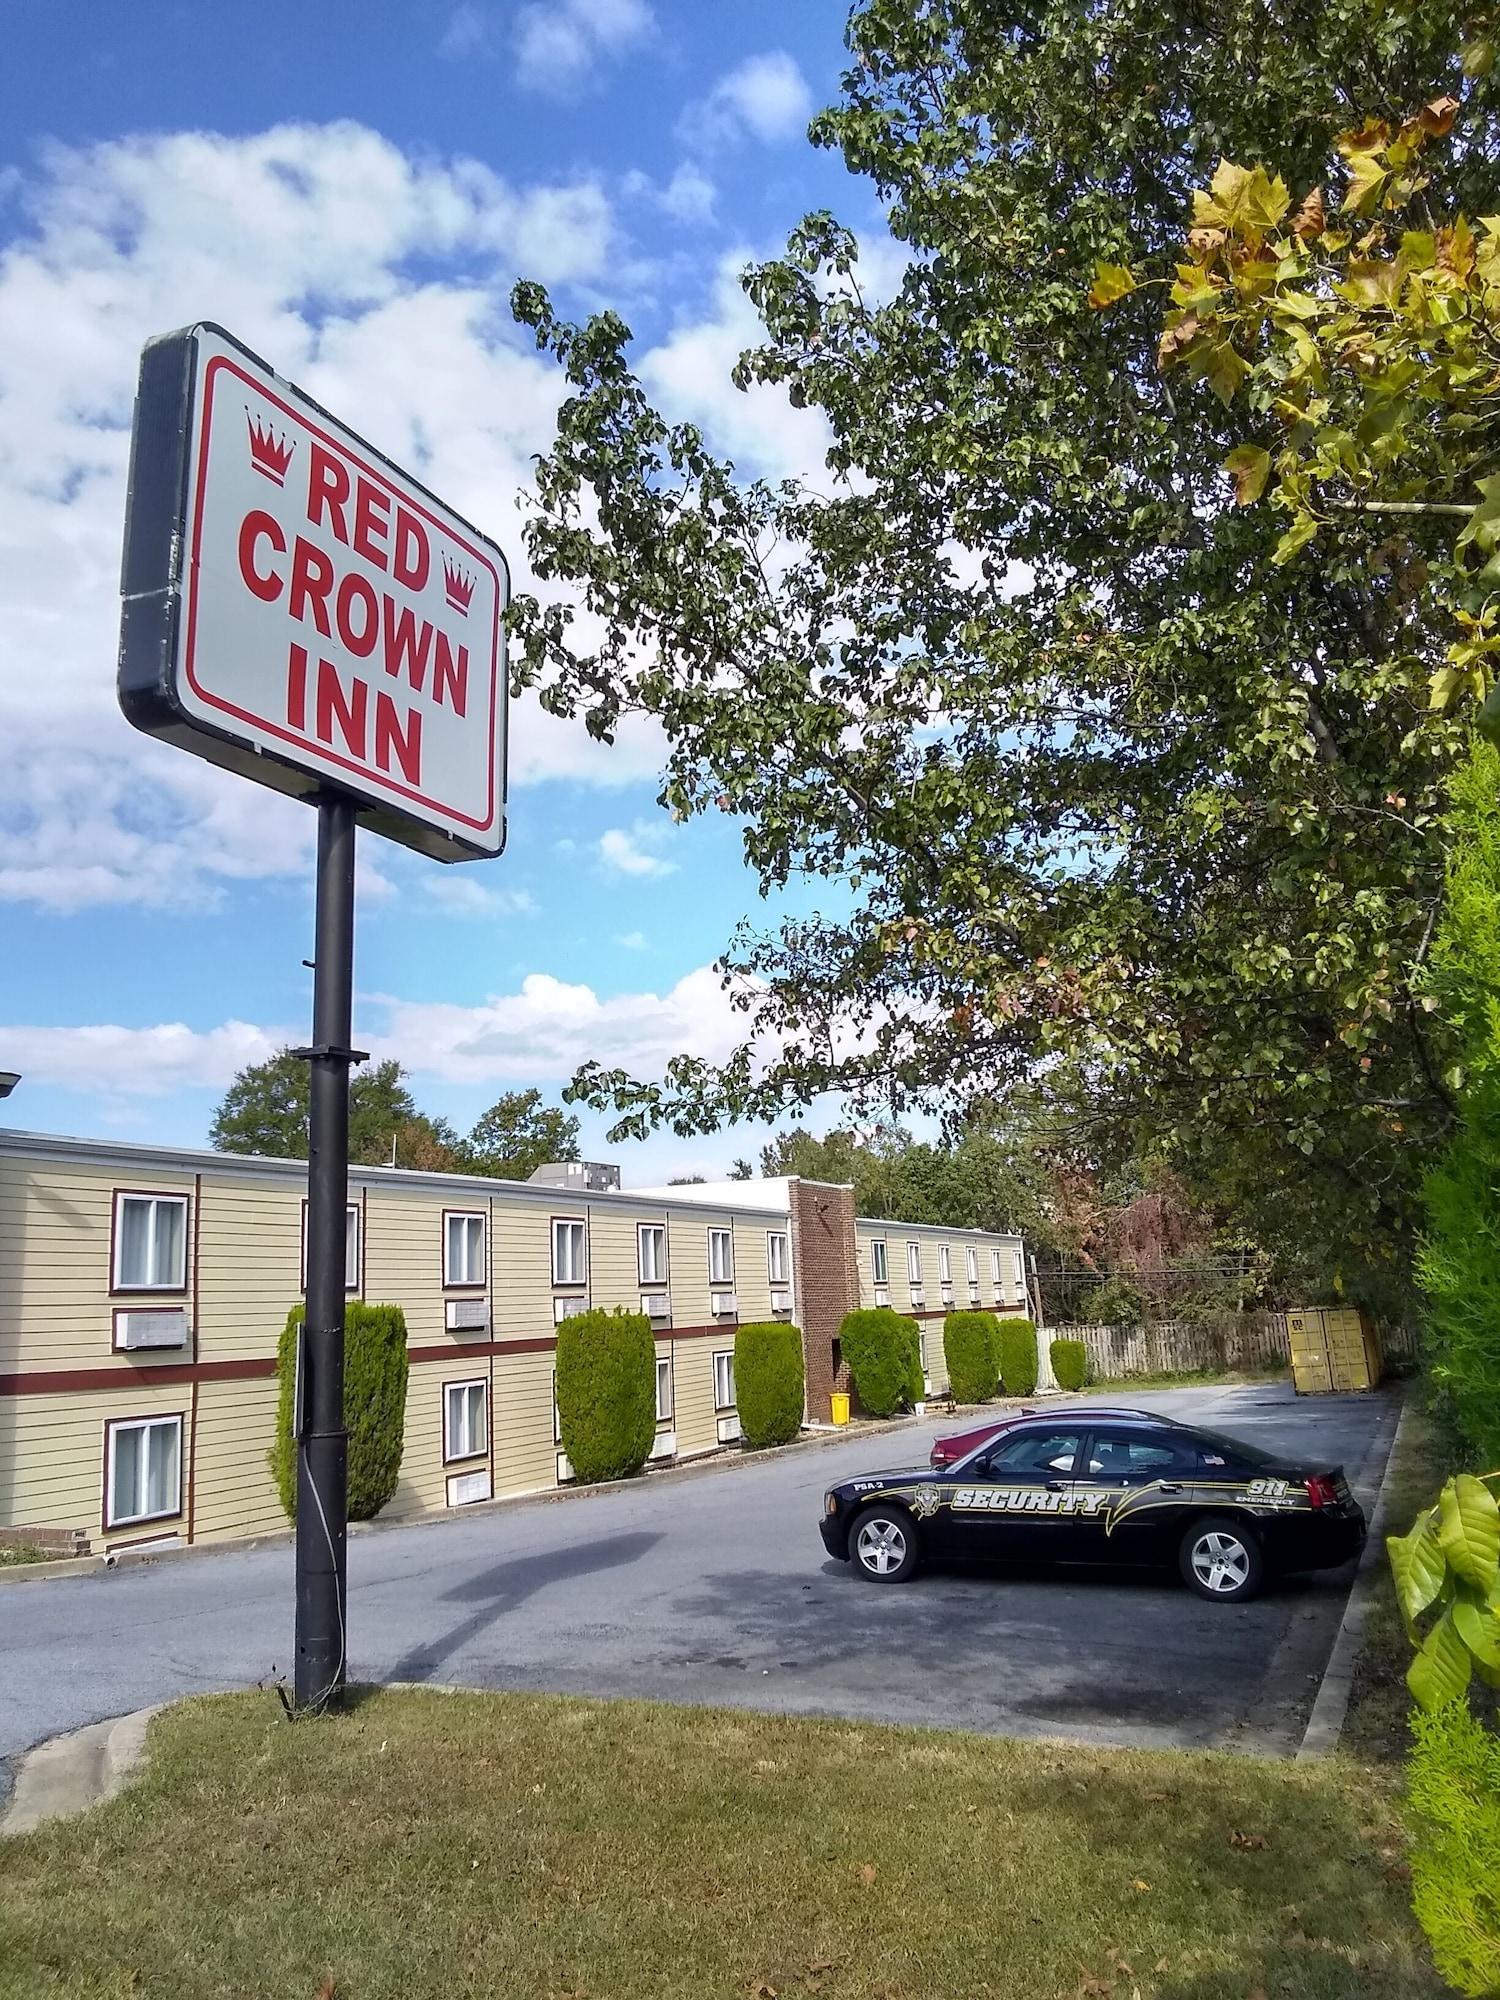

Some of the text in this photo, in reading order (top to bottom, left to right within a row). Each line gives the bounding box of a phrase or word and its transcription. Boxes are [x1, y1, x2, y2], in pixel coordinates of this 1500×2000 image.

[307, 442, 431, 591] RED
[238, 510, 468, 717] CROWN
[287, 643, 422, 786] INN
[953, 1489, 1107, 1514] SECURITY
[1235, 1496, 1295, 1505] EMERGENCY
[1249, 1480, 1287, 1497] 911
